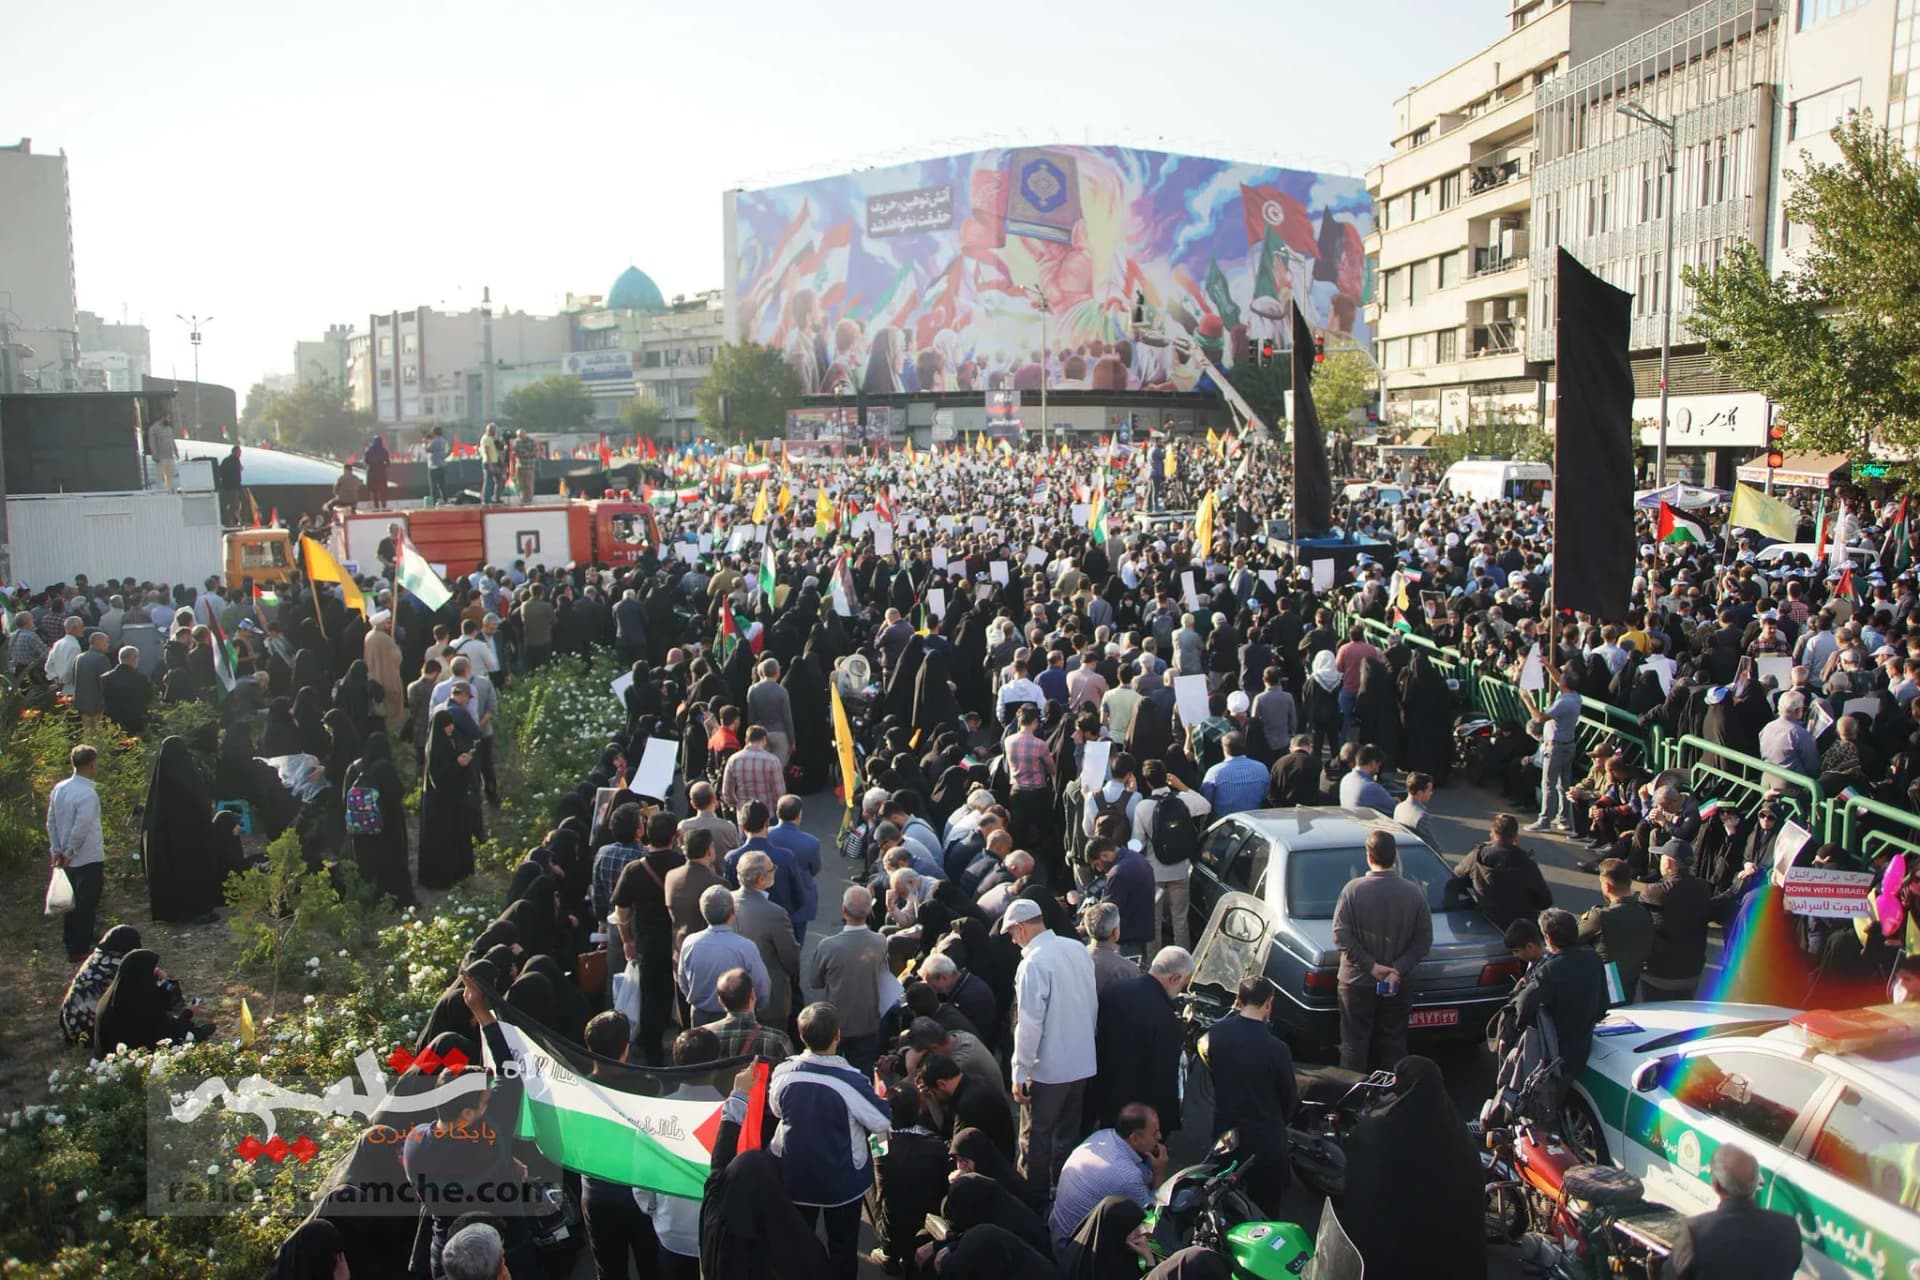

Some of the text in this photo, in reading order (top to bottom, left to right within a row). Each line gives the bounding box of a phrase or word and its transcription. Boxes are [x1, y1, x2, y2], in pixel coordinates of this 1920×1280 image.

[1785, 886, 1867, 895] DOWN WITH ISRAEL
[1794, 1212, 1888, 1280] پلیس
